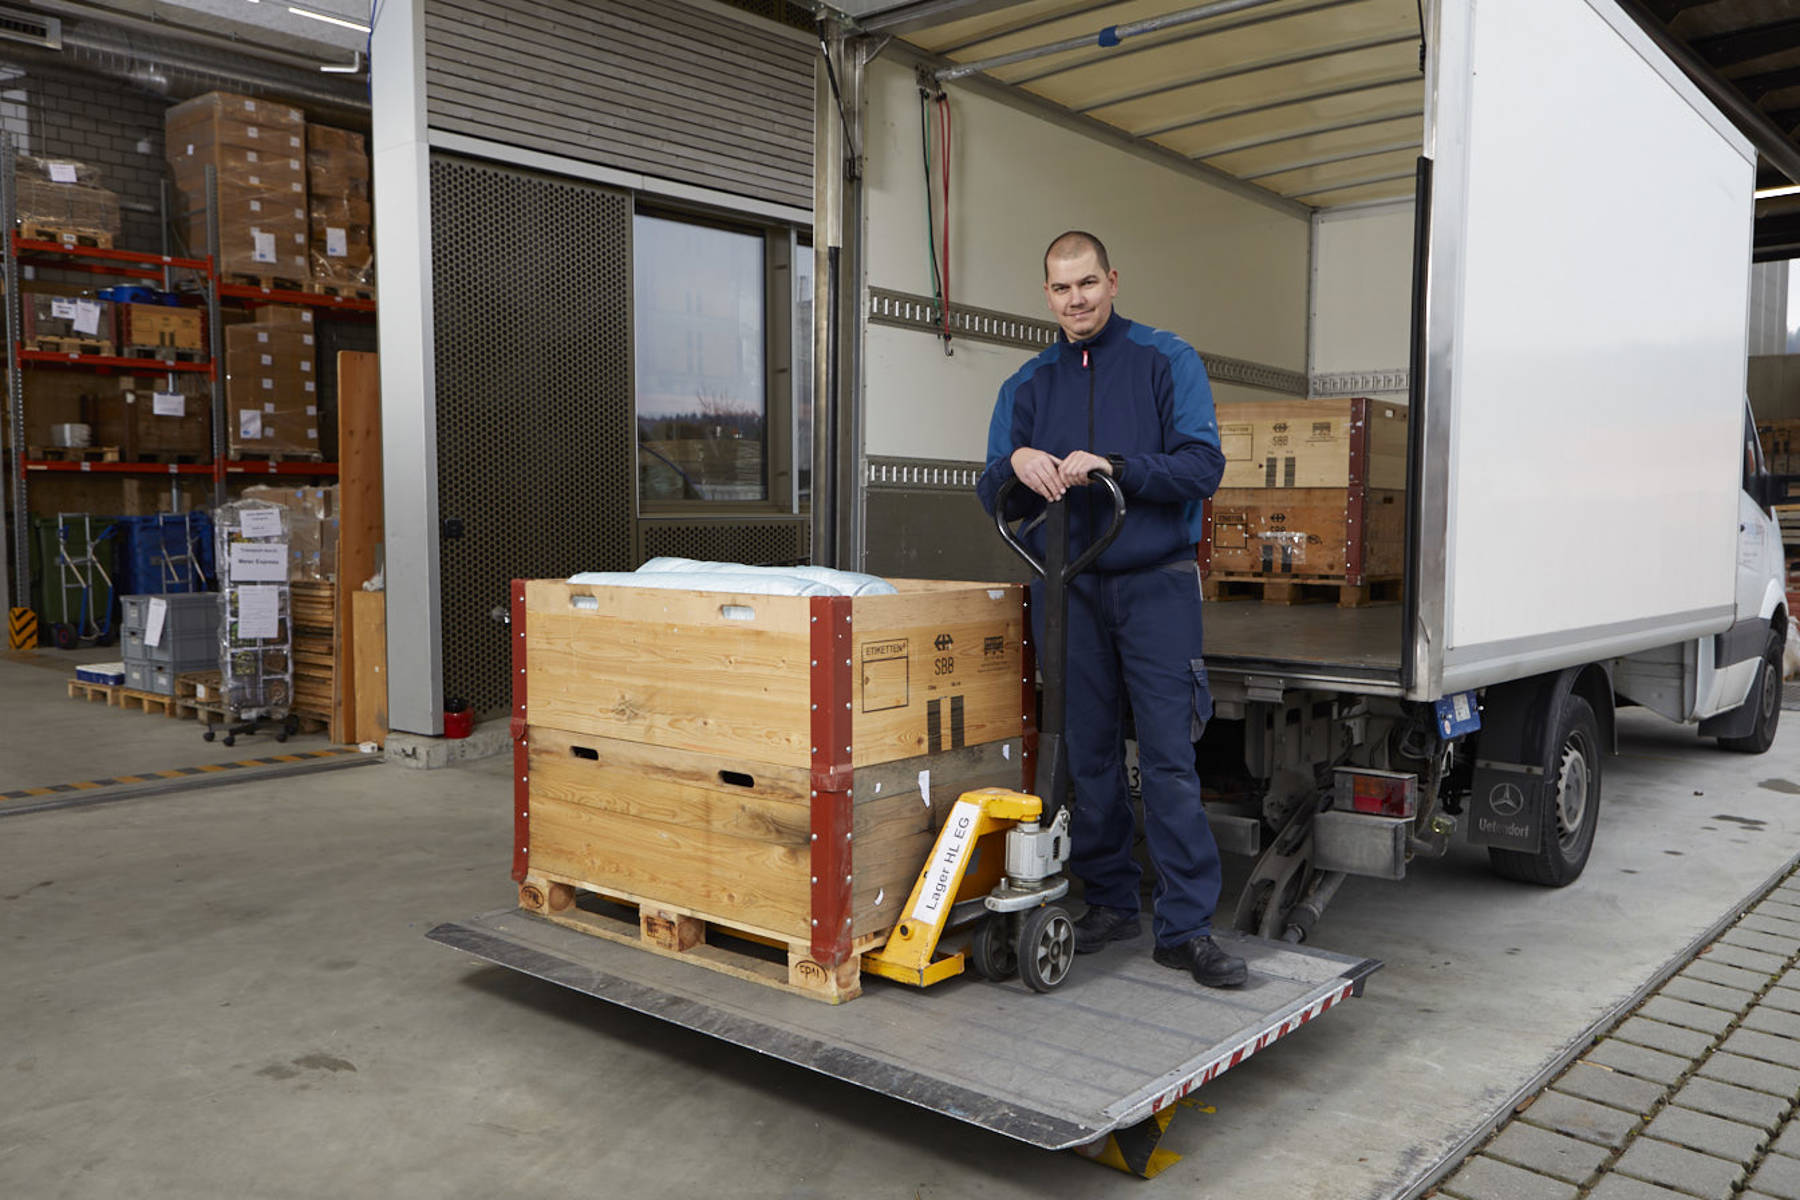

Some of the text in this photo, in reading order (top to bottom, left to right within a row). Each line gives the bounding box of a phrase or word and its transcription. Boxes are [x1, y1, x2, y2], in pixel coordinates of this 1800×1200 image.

[934, 656, 954, 676] SBB
[925, 816, 970, 911] Lager HL EG
